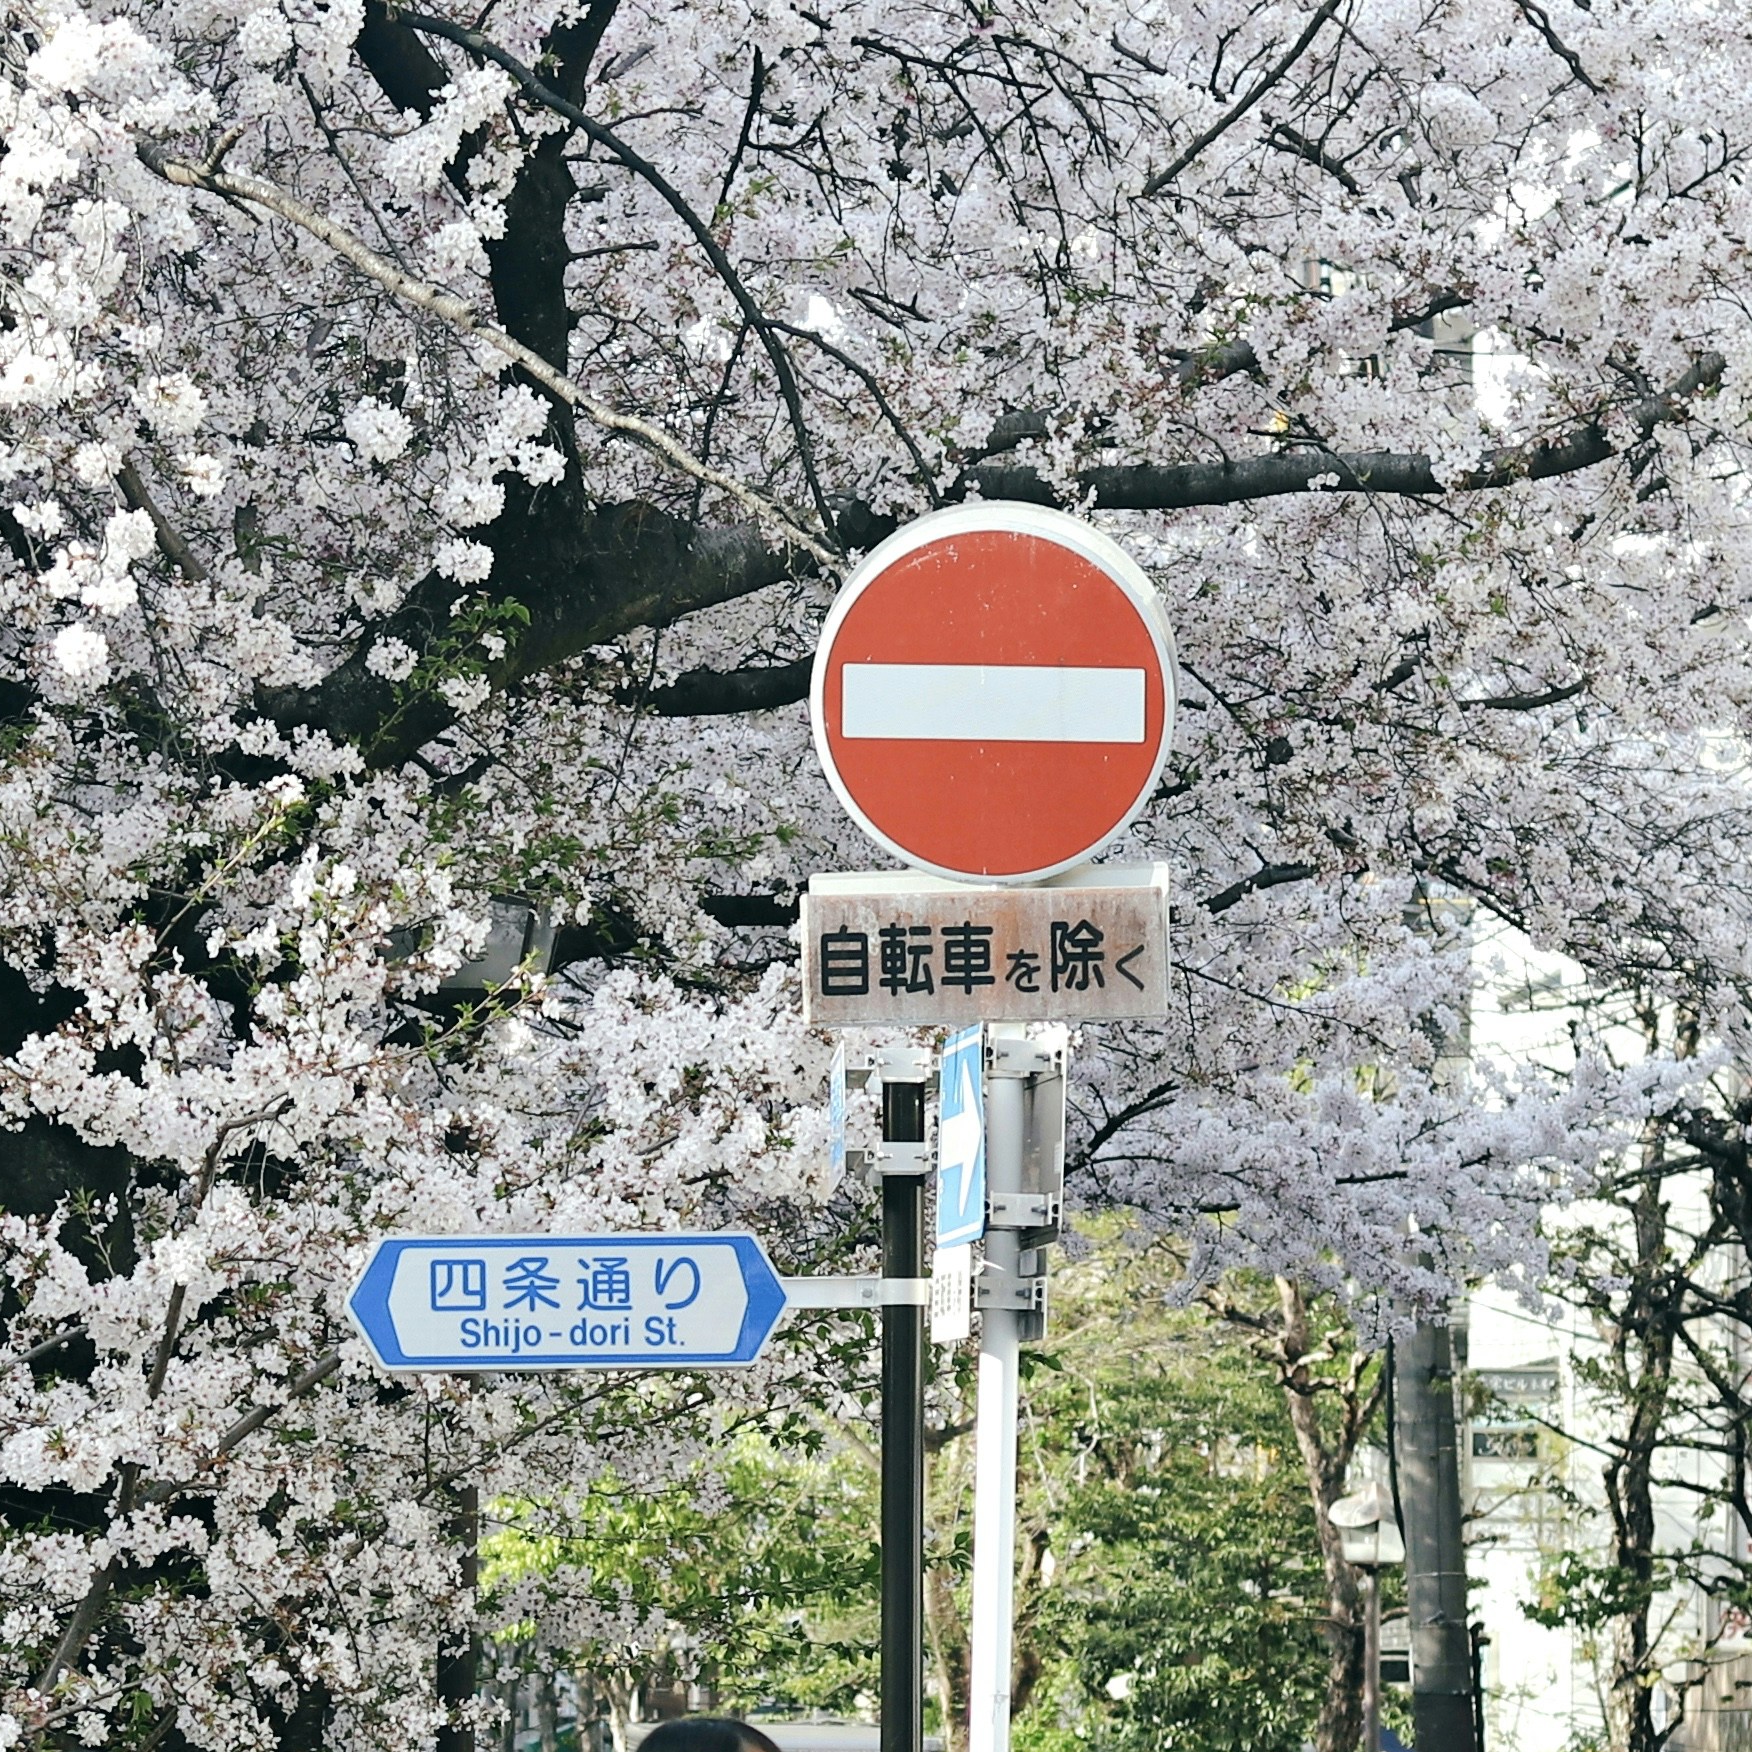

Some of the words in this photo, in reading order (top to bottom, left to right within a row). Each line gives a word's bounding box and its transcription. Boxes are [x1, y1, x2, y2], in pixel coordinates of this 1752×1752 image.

[821, 919, 1145, 997] 自転車を除く
[430, 1256, 702, 1313] 四条通り
[460, 1316, 630, 1353] Shijo-dori
[644, 1316, 686, 1347] St.
